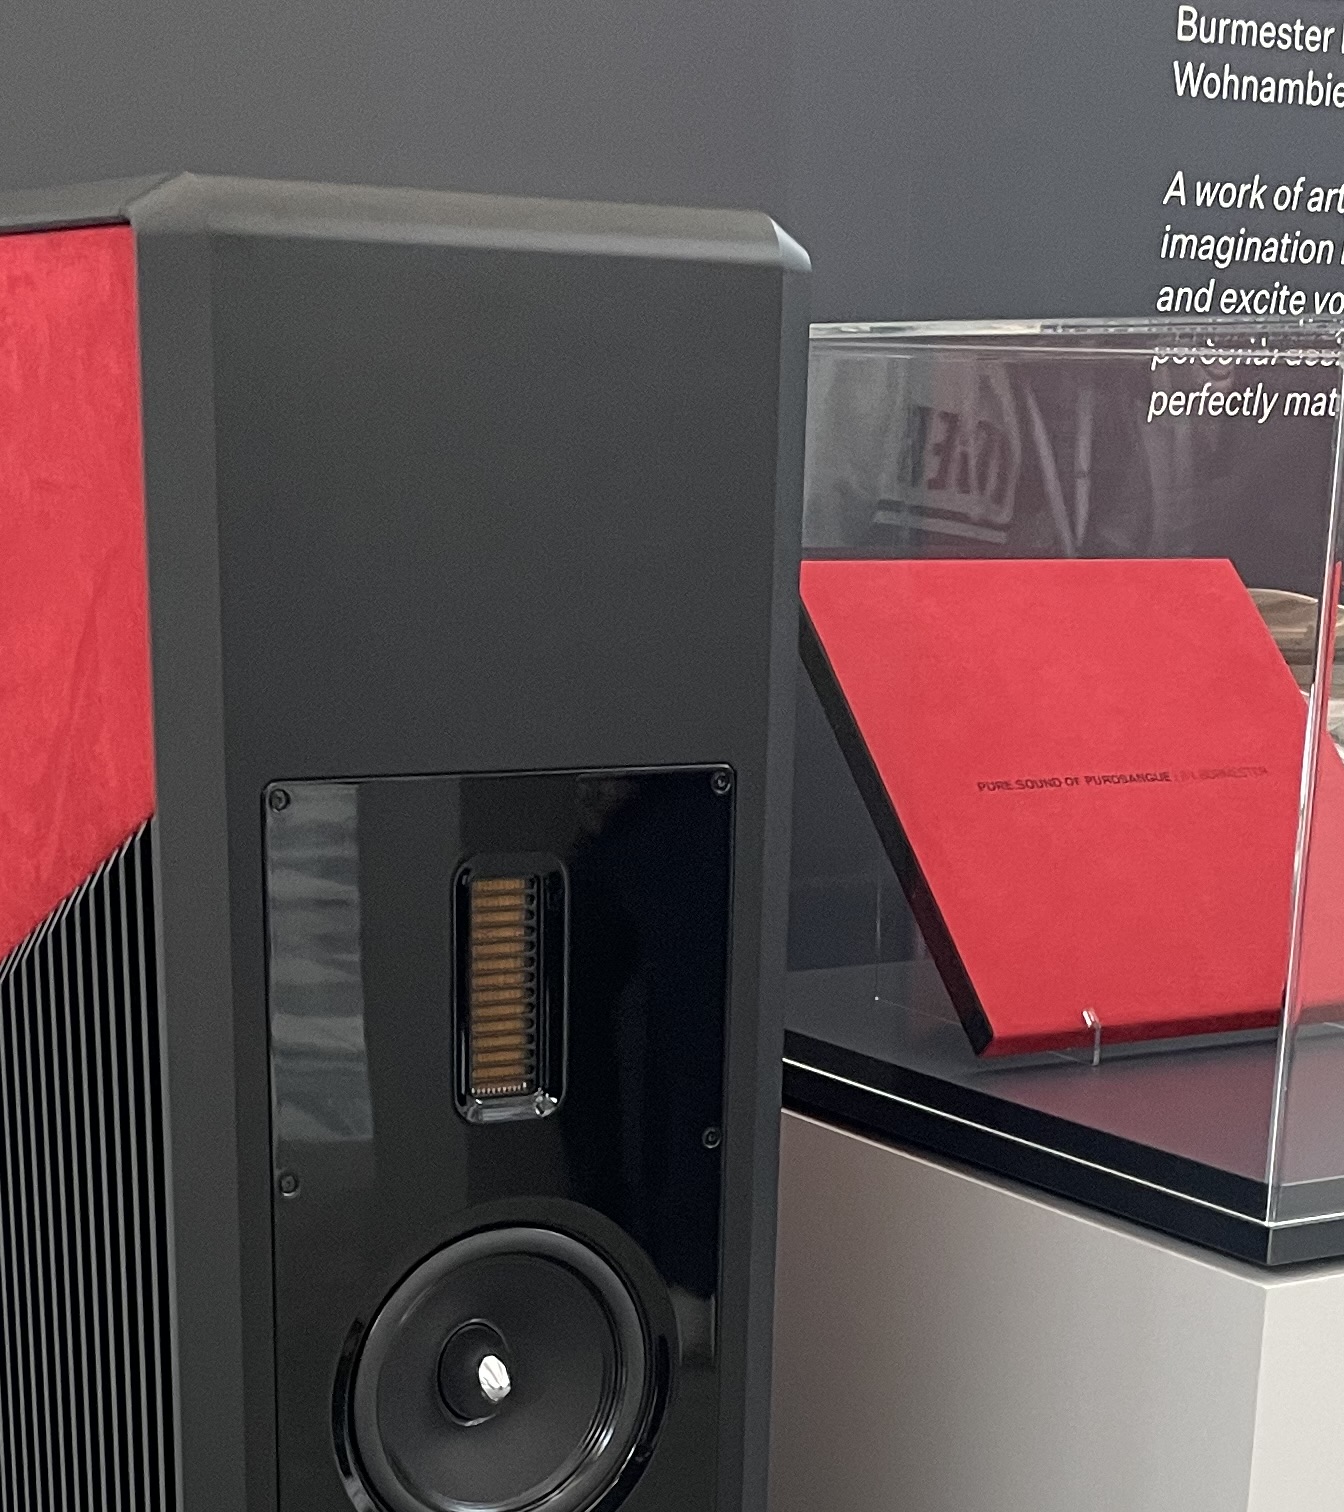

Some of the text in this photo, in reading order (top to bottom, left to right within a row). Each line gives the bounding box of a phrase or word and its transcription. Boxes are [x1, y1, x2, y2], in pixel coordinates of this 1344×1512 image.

[1178, 5, 1335, 52] Burmester
[1163, 171, 1185, 205] A
[1196, 174, 1267, 209] work
[1274, 177, 1305, 210] of
[1161, 225, 1334, 268] imagination
[1156, 279, 1215, 314] and
[1219, 282, 1306, 315] excite
[1147, 382, 1278, 423] perfectly
[976, 780, 1013, 793] PURE
[1014, 777, 1063, 790] SOUND
